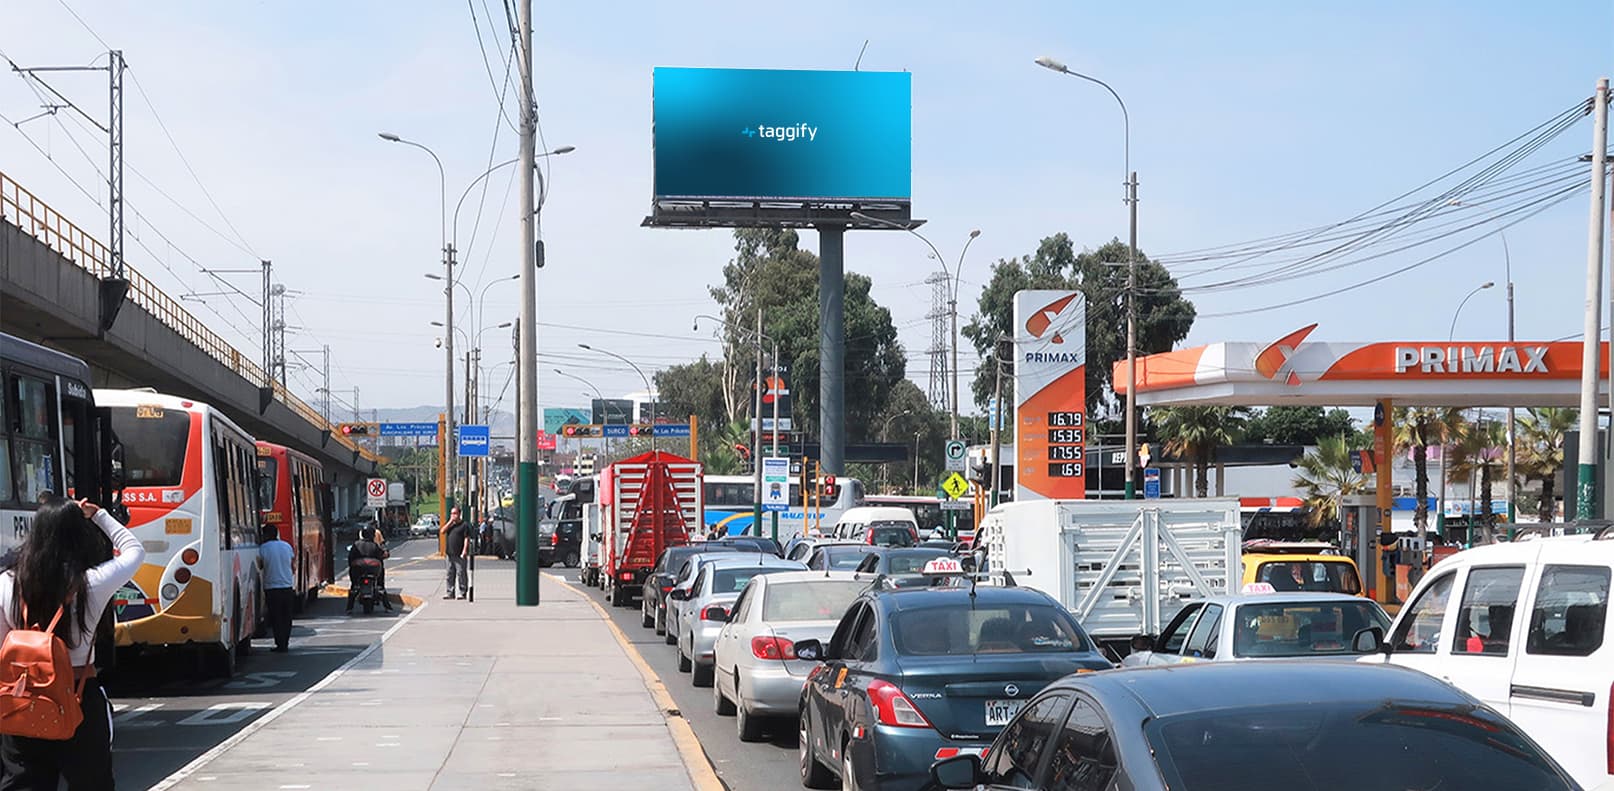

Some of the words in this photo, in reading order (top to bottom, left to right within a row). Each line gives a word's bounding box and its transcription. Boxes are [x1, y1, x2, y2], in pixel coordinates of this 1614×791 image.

[758, 122, 818, 142] taggify
[1025, 352, 1078, 363] PRIMAX
[1394, 346, 1549, 373] PRIMAX
[1052, 412, 1082, 426] 16.79
[1052, 429, 1082, 443] 15.35
[1052, 446, 1082, 460] 17.55
[139, 492, 157, 502] S.A.
[931, 561, 957, 571] TAXI
[1248, 584, 1272, 592] TAXI
